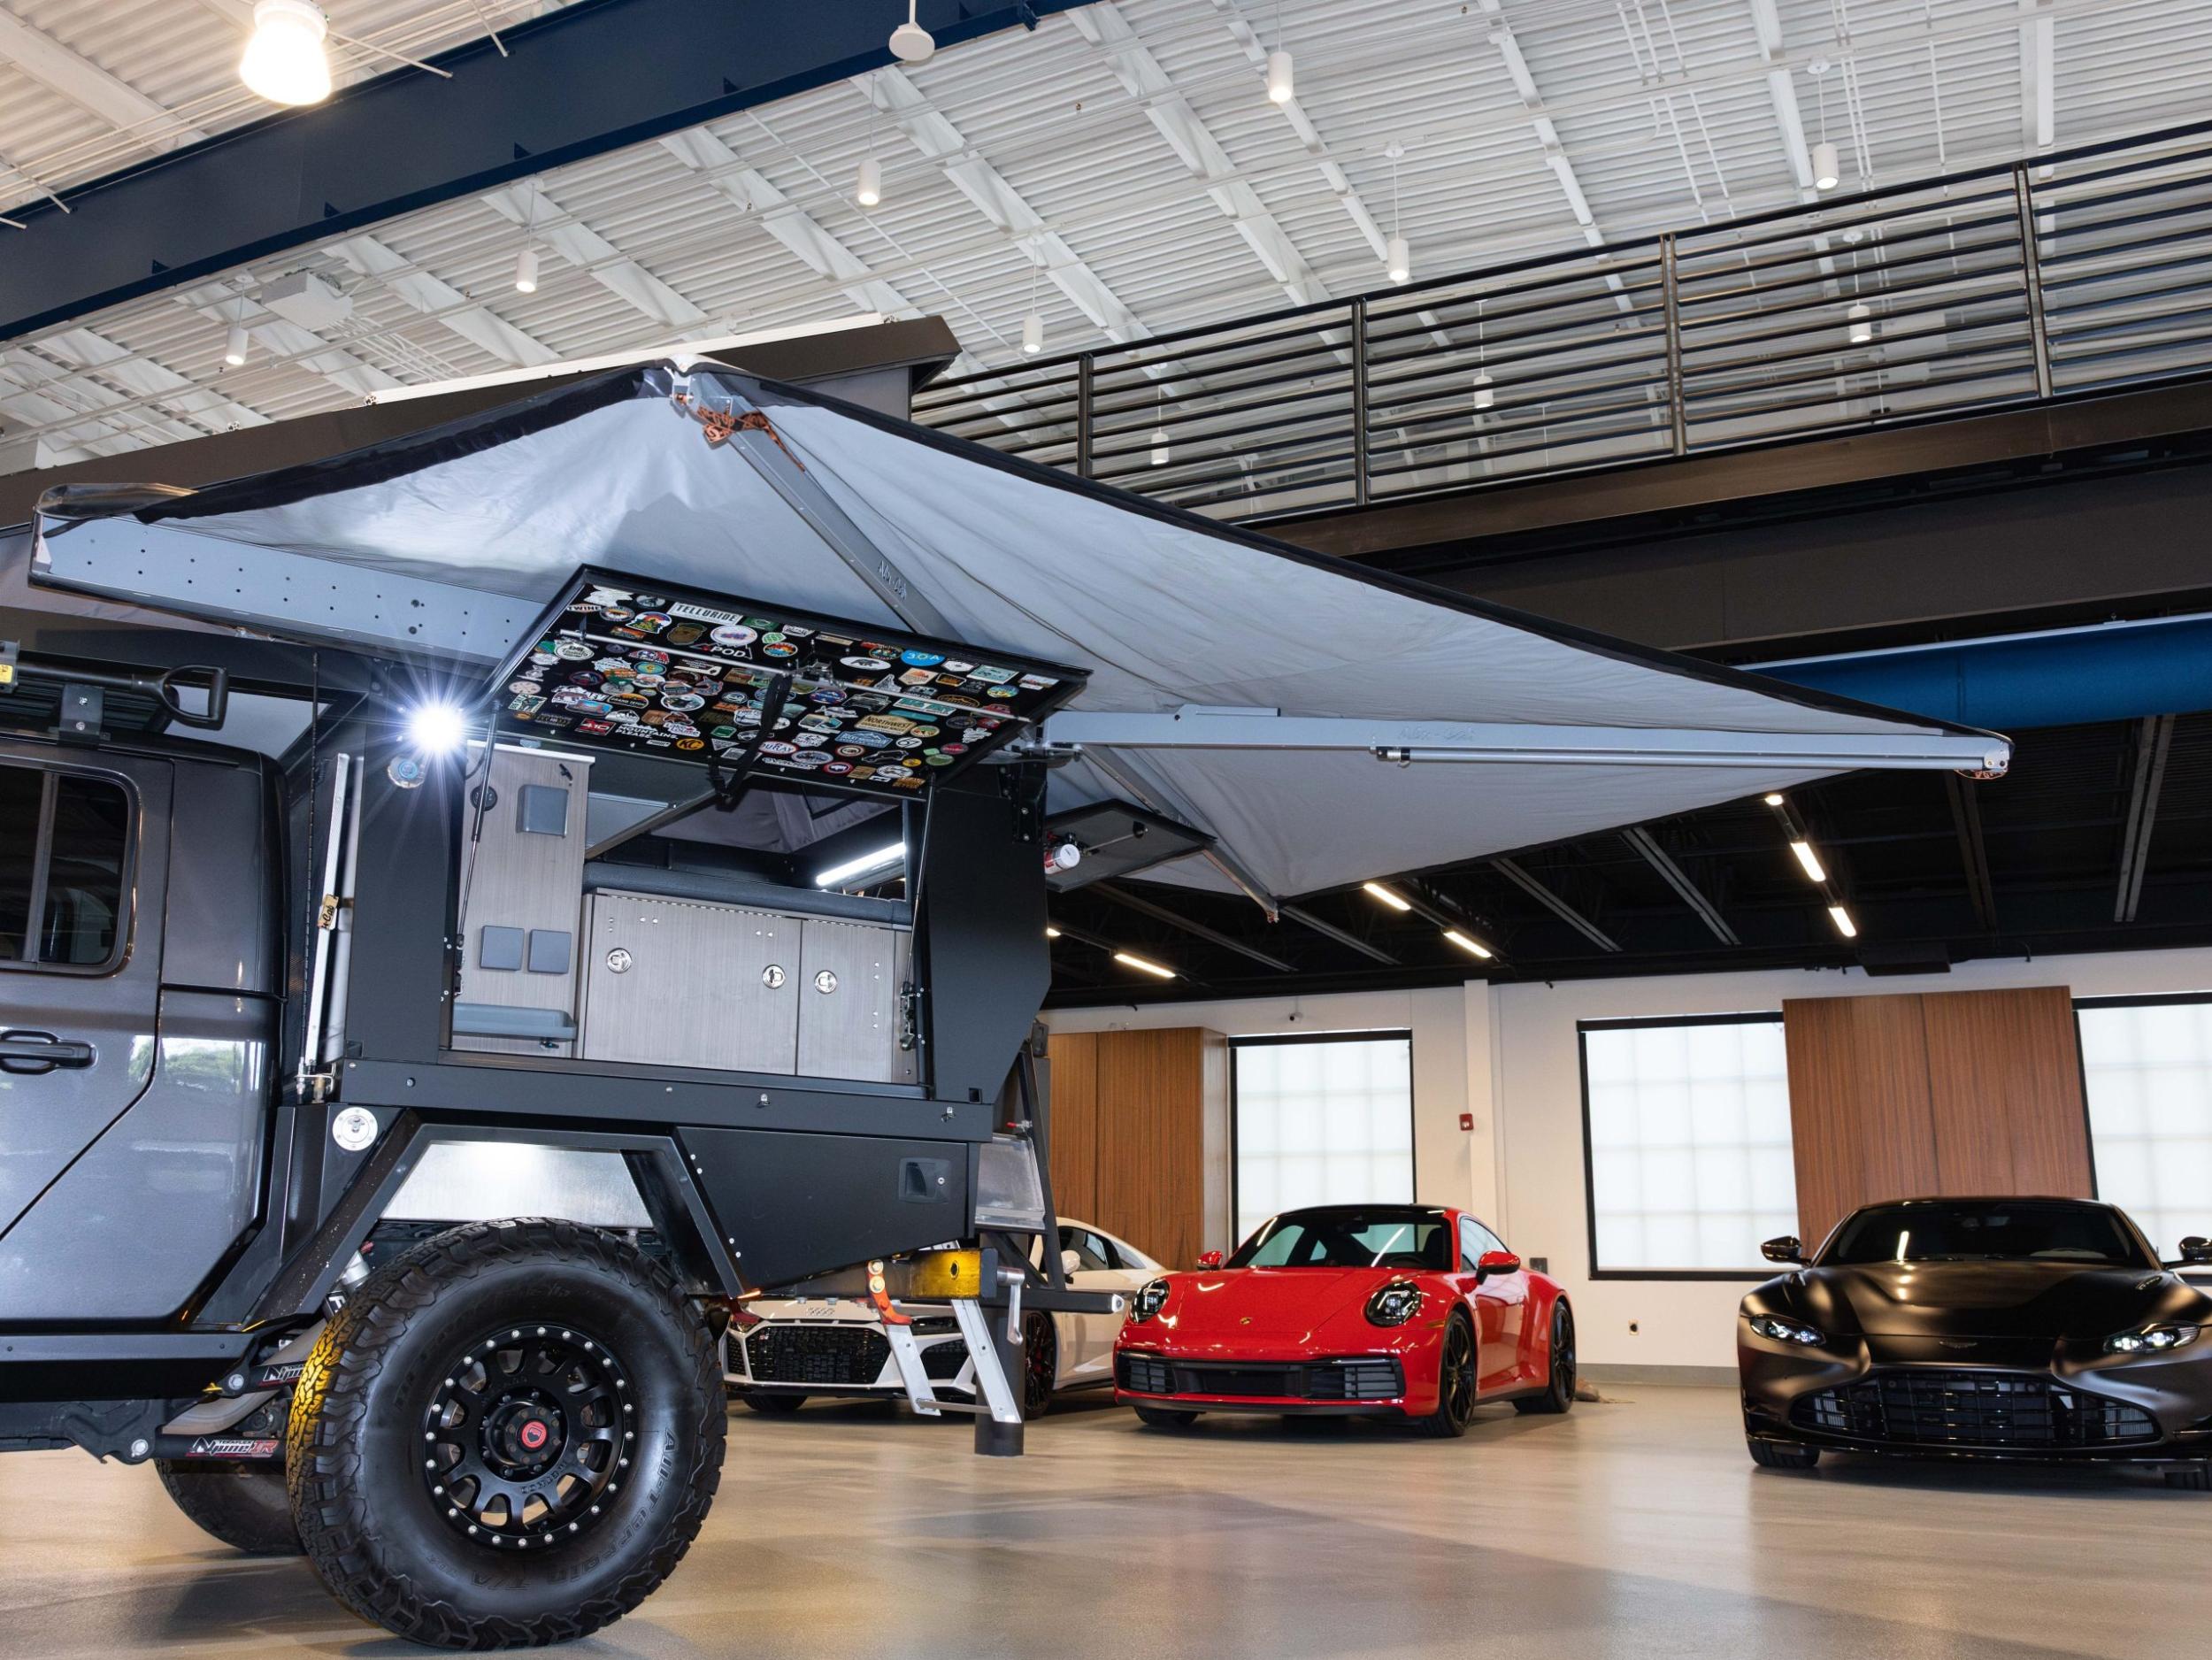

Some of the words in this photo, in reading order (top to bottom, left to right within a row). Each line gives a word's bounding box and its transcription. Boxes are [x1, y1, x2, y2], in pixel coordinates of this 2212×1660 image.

[676, 604, 737, 622] TELLURIDE
[906, 651, 941, 661] 30A
[866, 716, 910, 728] NORTHWEST
[678, 739, 703, 749] KC
[896, 736, 922, 748] 67
